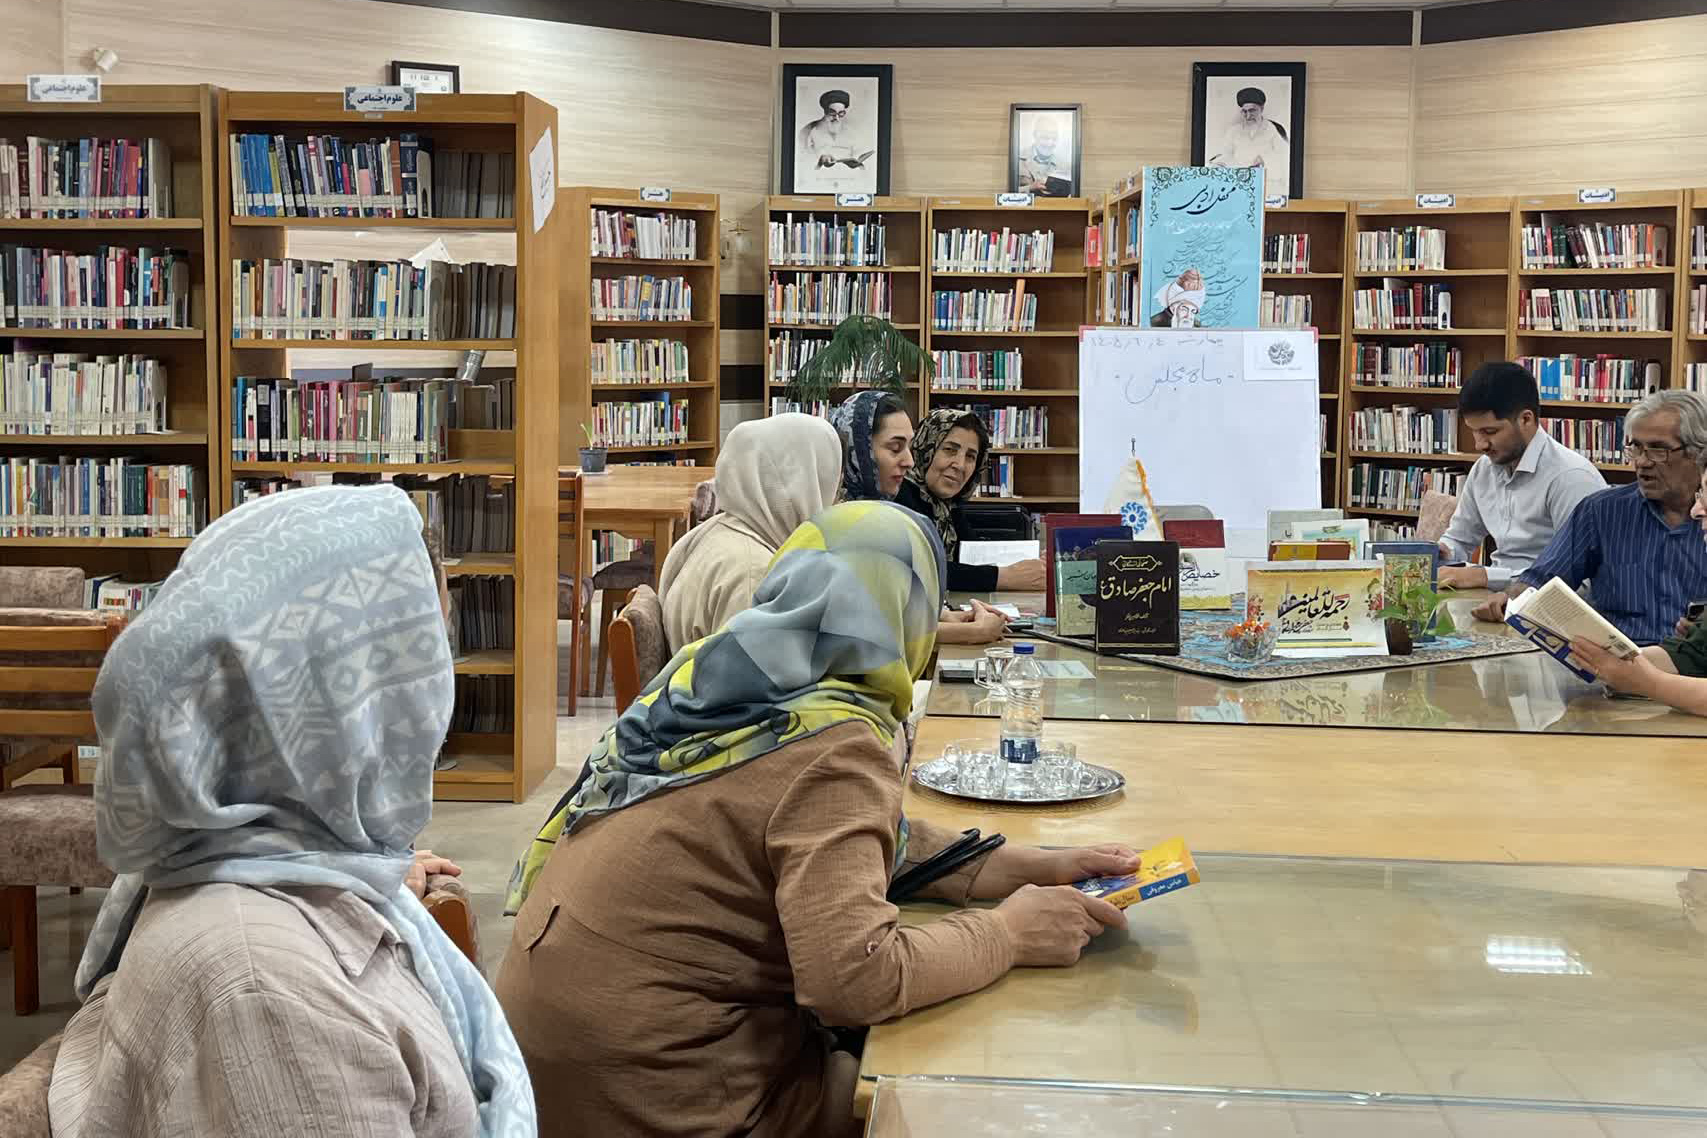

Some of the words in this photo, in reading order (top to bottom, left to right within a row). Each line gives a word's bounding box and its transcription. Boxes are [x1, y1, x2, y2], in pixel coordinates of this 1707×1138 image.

[357, 93, 387, 104] اجتماعی
[386, 94, 403, 105] علوم
[1169, 184, 1214, 211] ادبی
[1187, 186, 1236, 215] محفل
[1188, 354, 1222, 385] ماه
[1124, 365, 1185, 404] مجلس
[1100, 576, 1138, 600] صادق
[1129, 577, 1156, 602] جعفر
[1149, 576, 1172, 610] امام
